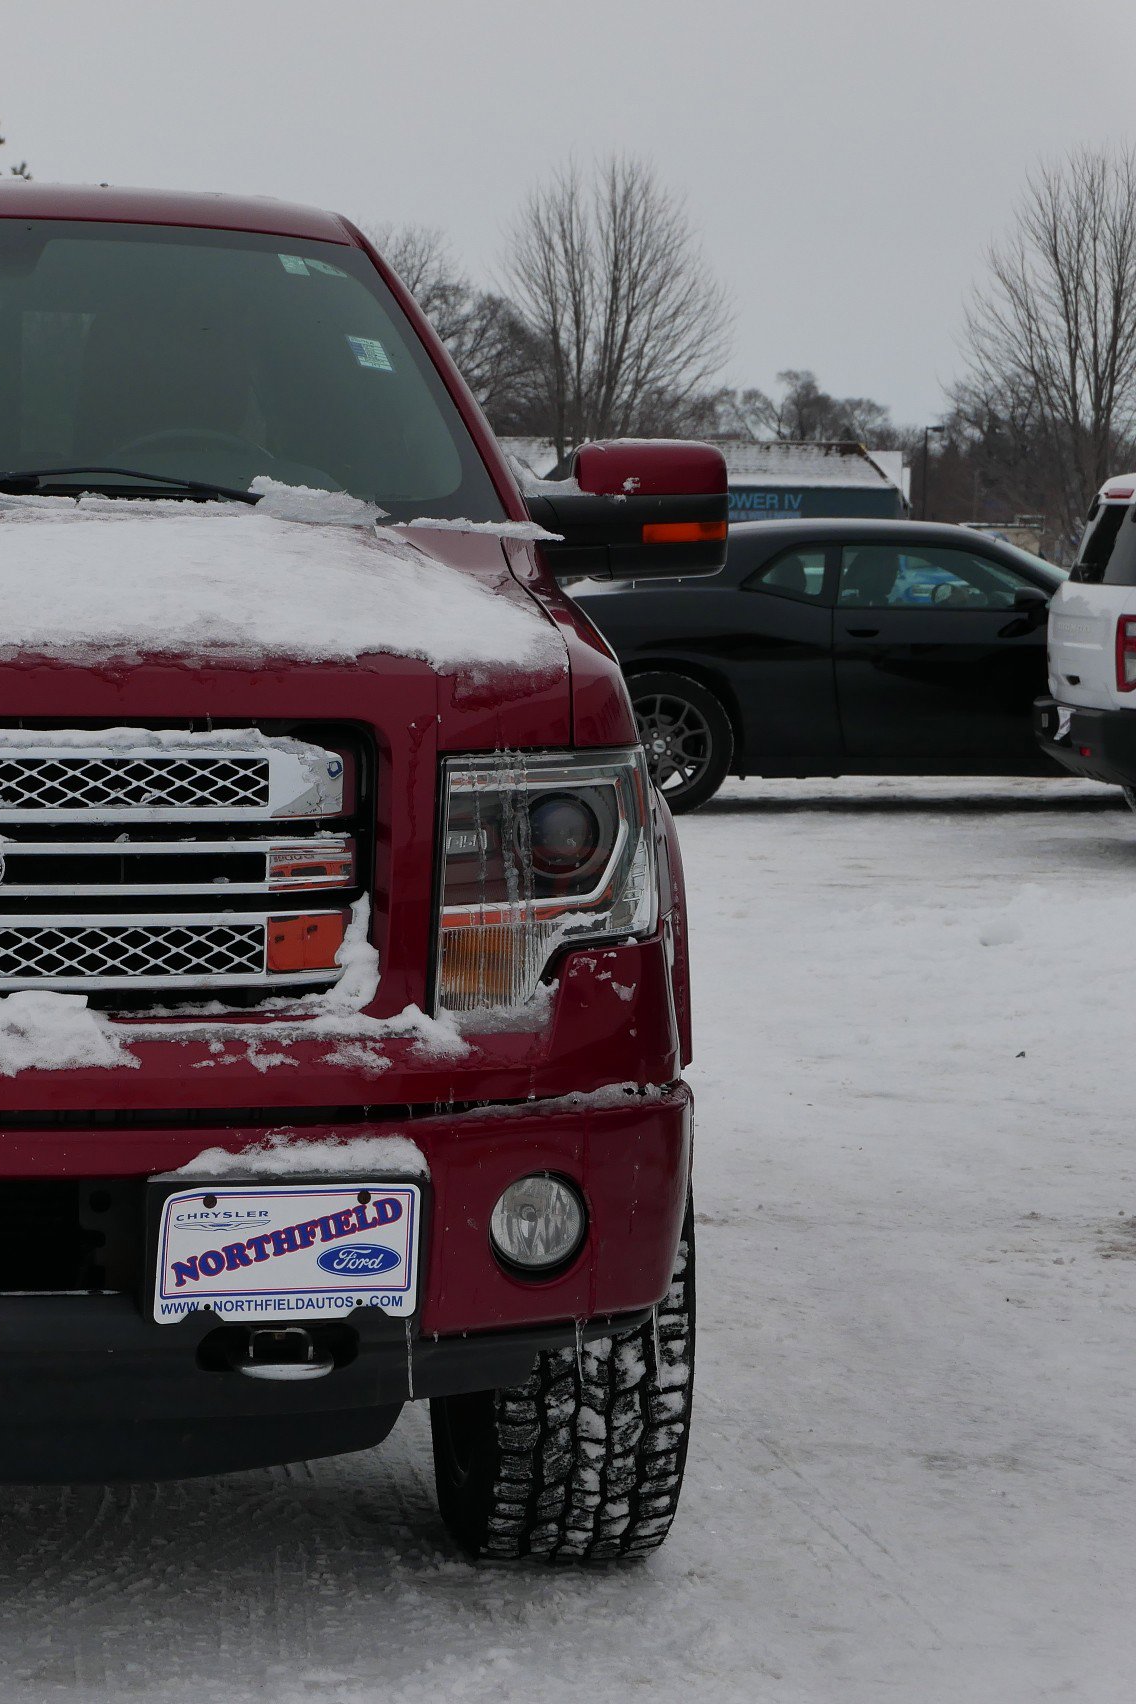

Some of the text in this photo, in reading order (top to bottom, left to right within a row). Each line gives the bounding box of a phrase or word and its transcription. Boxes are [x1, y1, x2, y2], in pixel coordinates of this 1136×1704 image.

[784, 493, 803, 509] IV
[176, 1210, 269, 1222] CHRYSLER
[170, 1197, 404, 1288] NORTHFIELD
[333, 1248, 384, 1270] Ford
[160, 1295, 404, 1316] WWWNORTHFIELDAUTOS.COM
